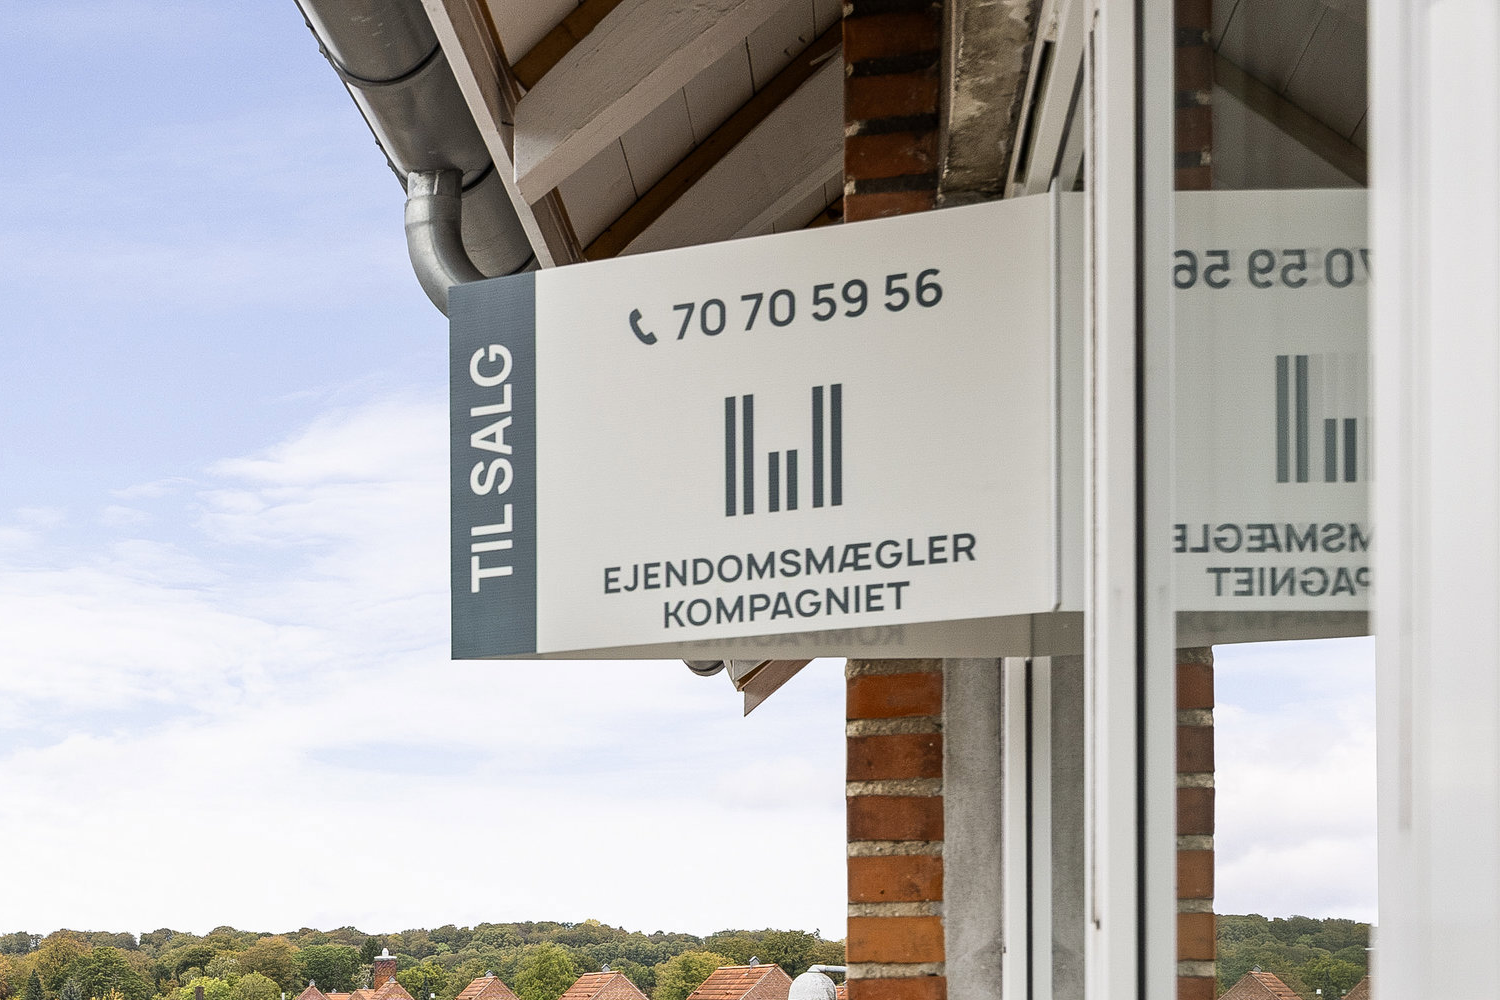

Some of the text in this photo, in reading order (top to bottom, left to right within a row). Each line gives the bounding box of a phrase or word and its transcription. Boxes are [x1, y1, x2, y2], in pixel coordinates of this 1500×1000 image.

[672, 268, 943, 340] 70 70 59 56
[469, 344, 513, 593] TIL SALG
[604, 533, 976, 594] EJENDOMSMÆGLER
[664, 581, 910, 628] KOMPAGNIET
